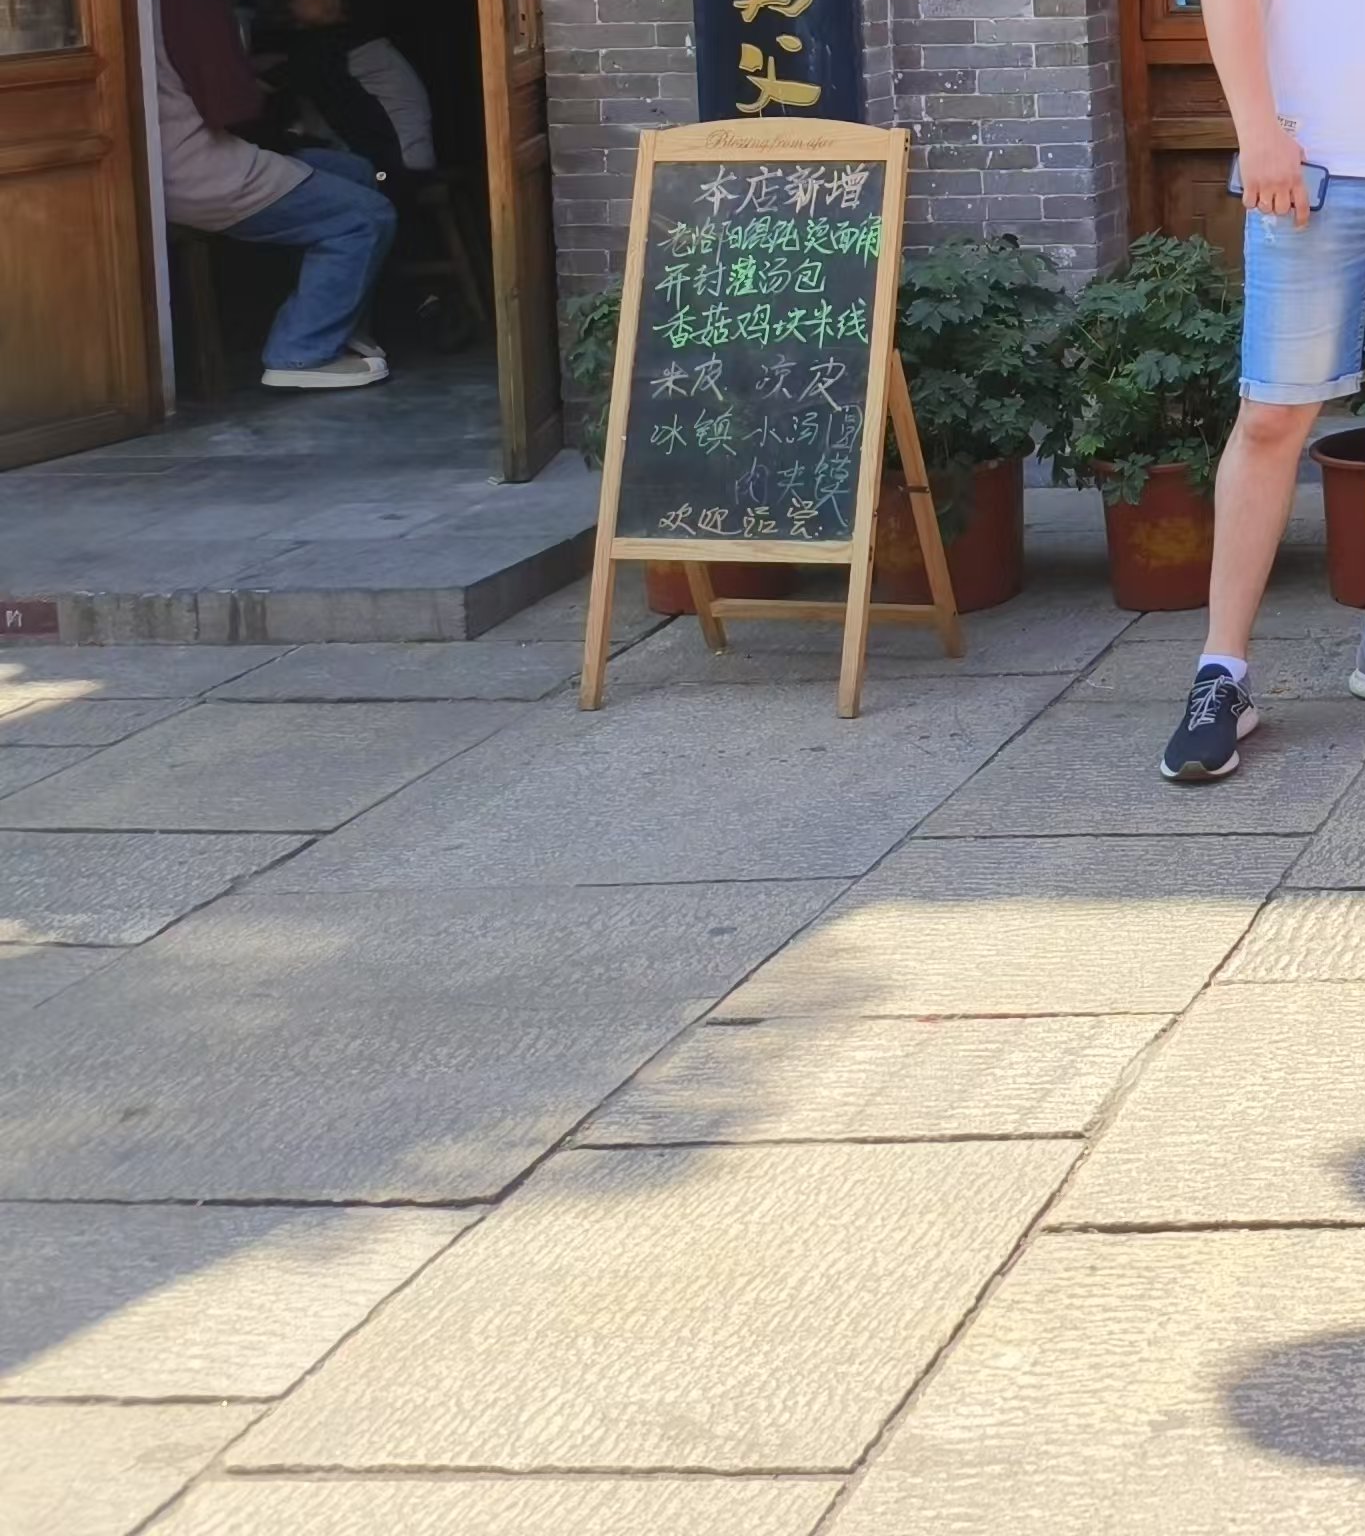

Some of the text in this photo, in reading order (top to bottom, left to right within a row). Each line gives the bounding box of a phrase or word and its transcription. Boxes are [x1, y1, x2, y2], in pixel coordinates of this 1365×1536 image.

[693, 164, 869, 217] 本店新增
[655, 254, 827, 310] 开封灌汤包
[652, 297, 870, 350] 香菇鸡块米线
